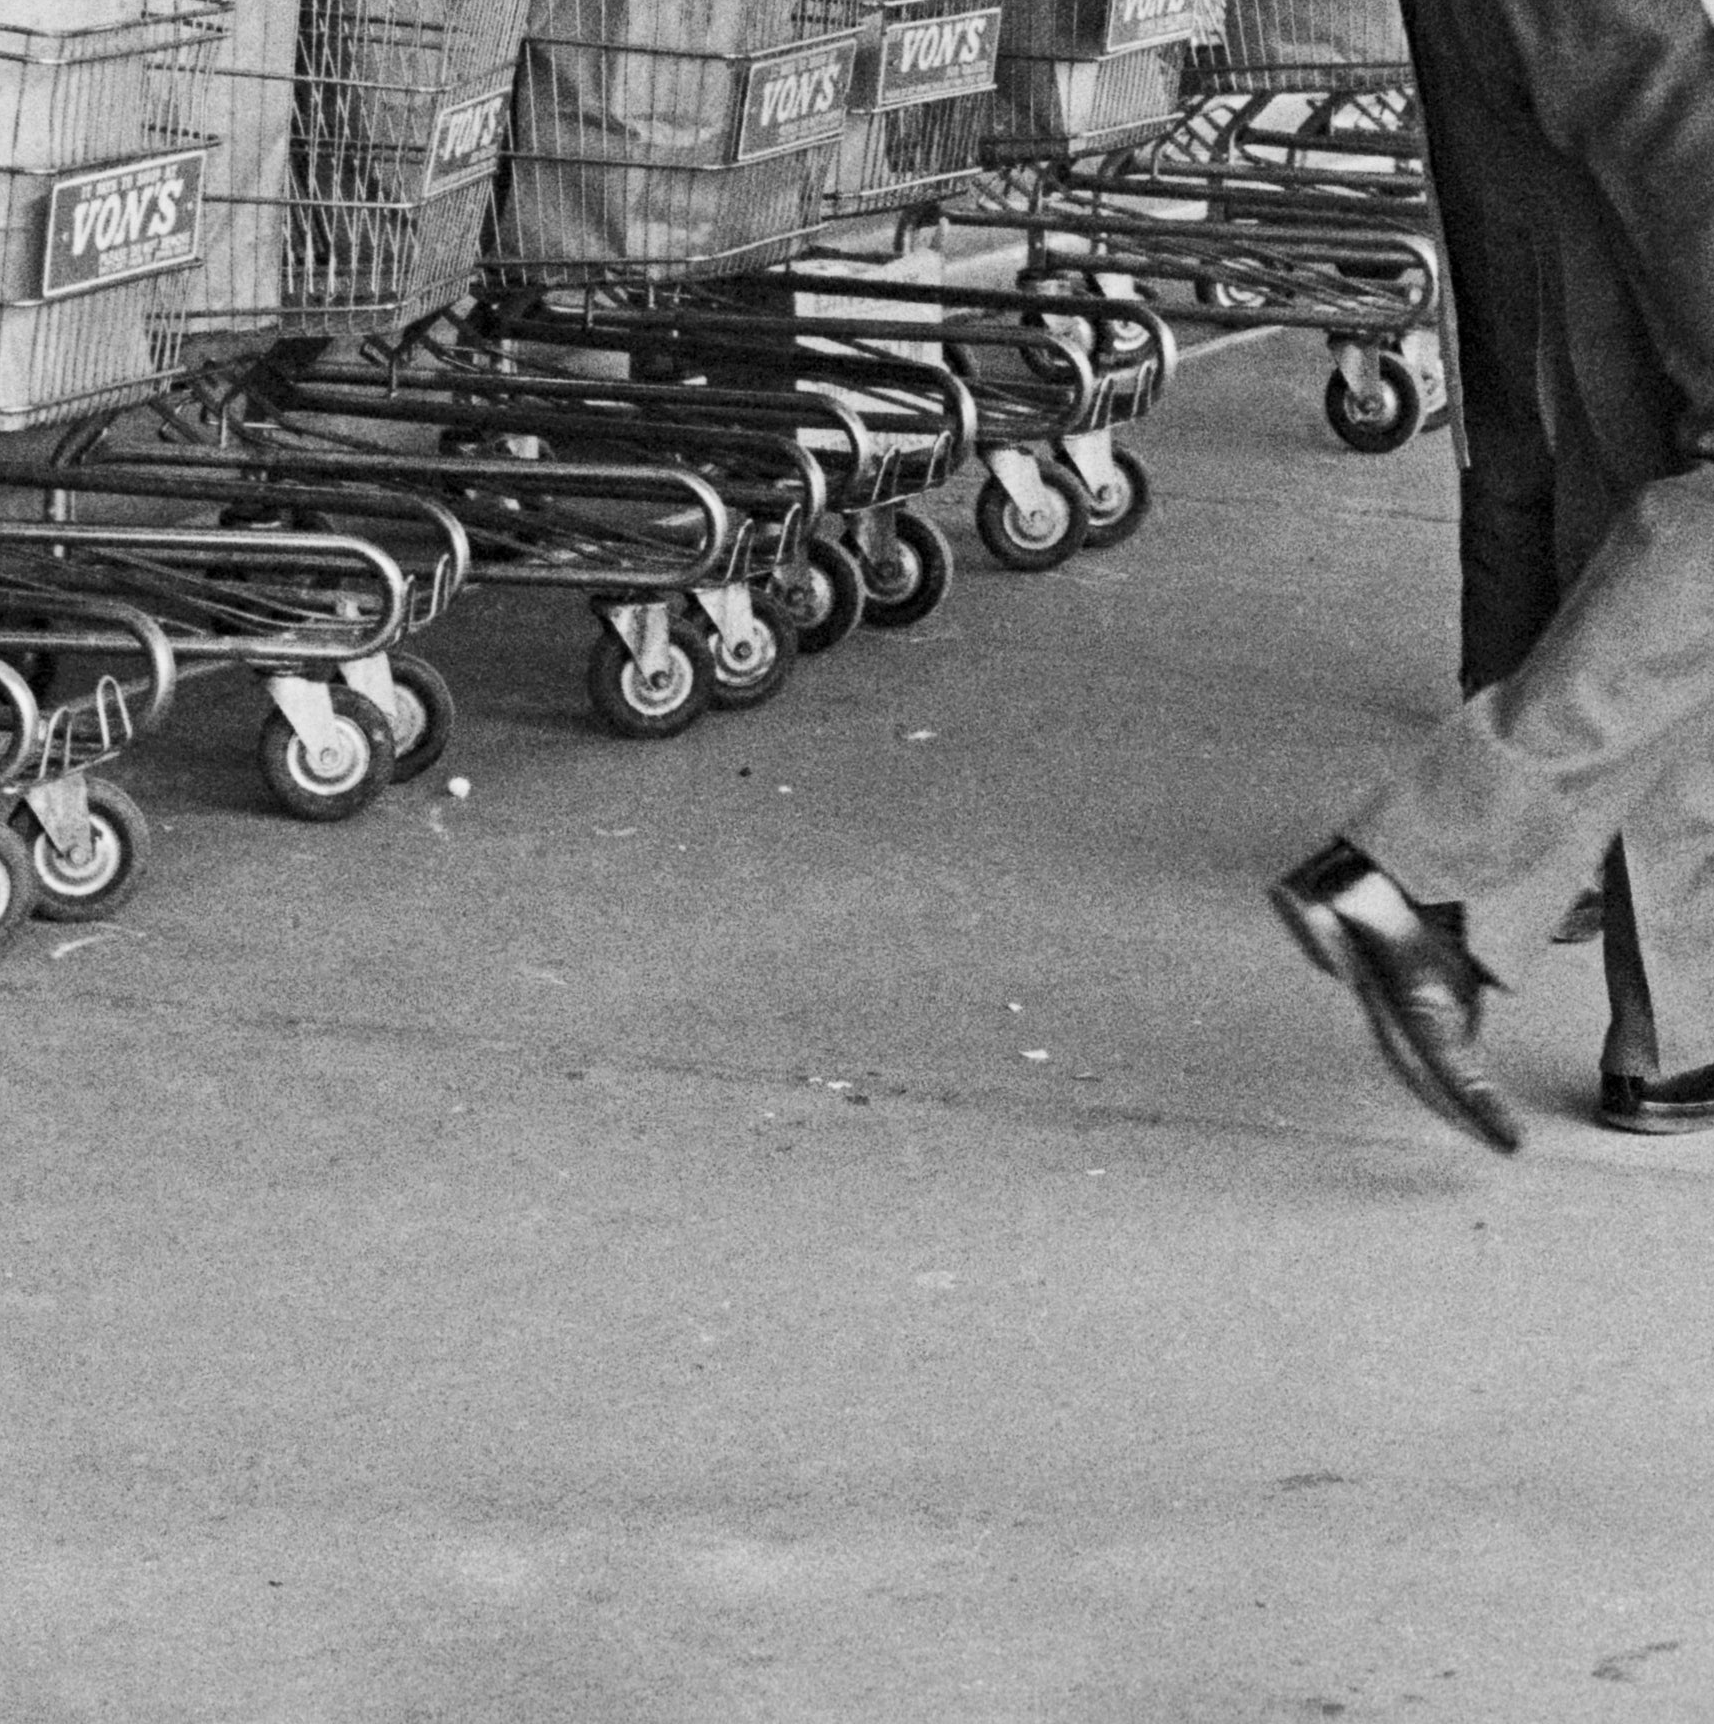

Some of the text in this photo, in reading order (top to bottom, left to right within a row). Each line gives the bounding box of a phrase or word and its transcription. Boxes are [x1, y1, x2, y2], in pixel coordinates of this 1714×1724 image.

[899, 17, 987, 74] VON'S
[760, 64, 843, 128] VON'S
[72, 177, 185, 256] VON'S
